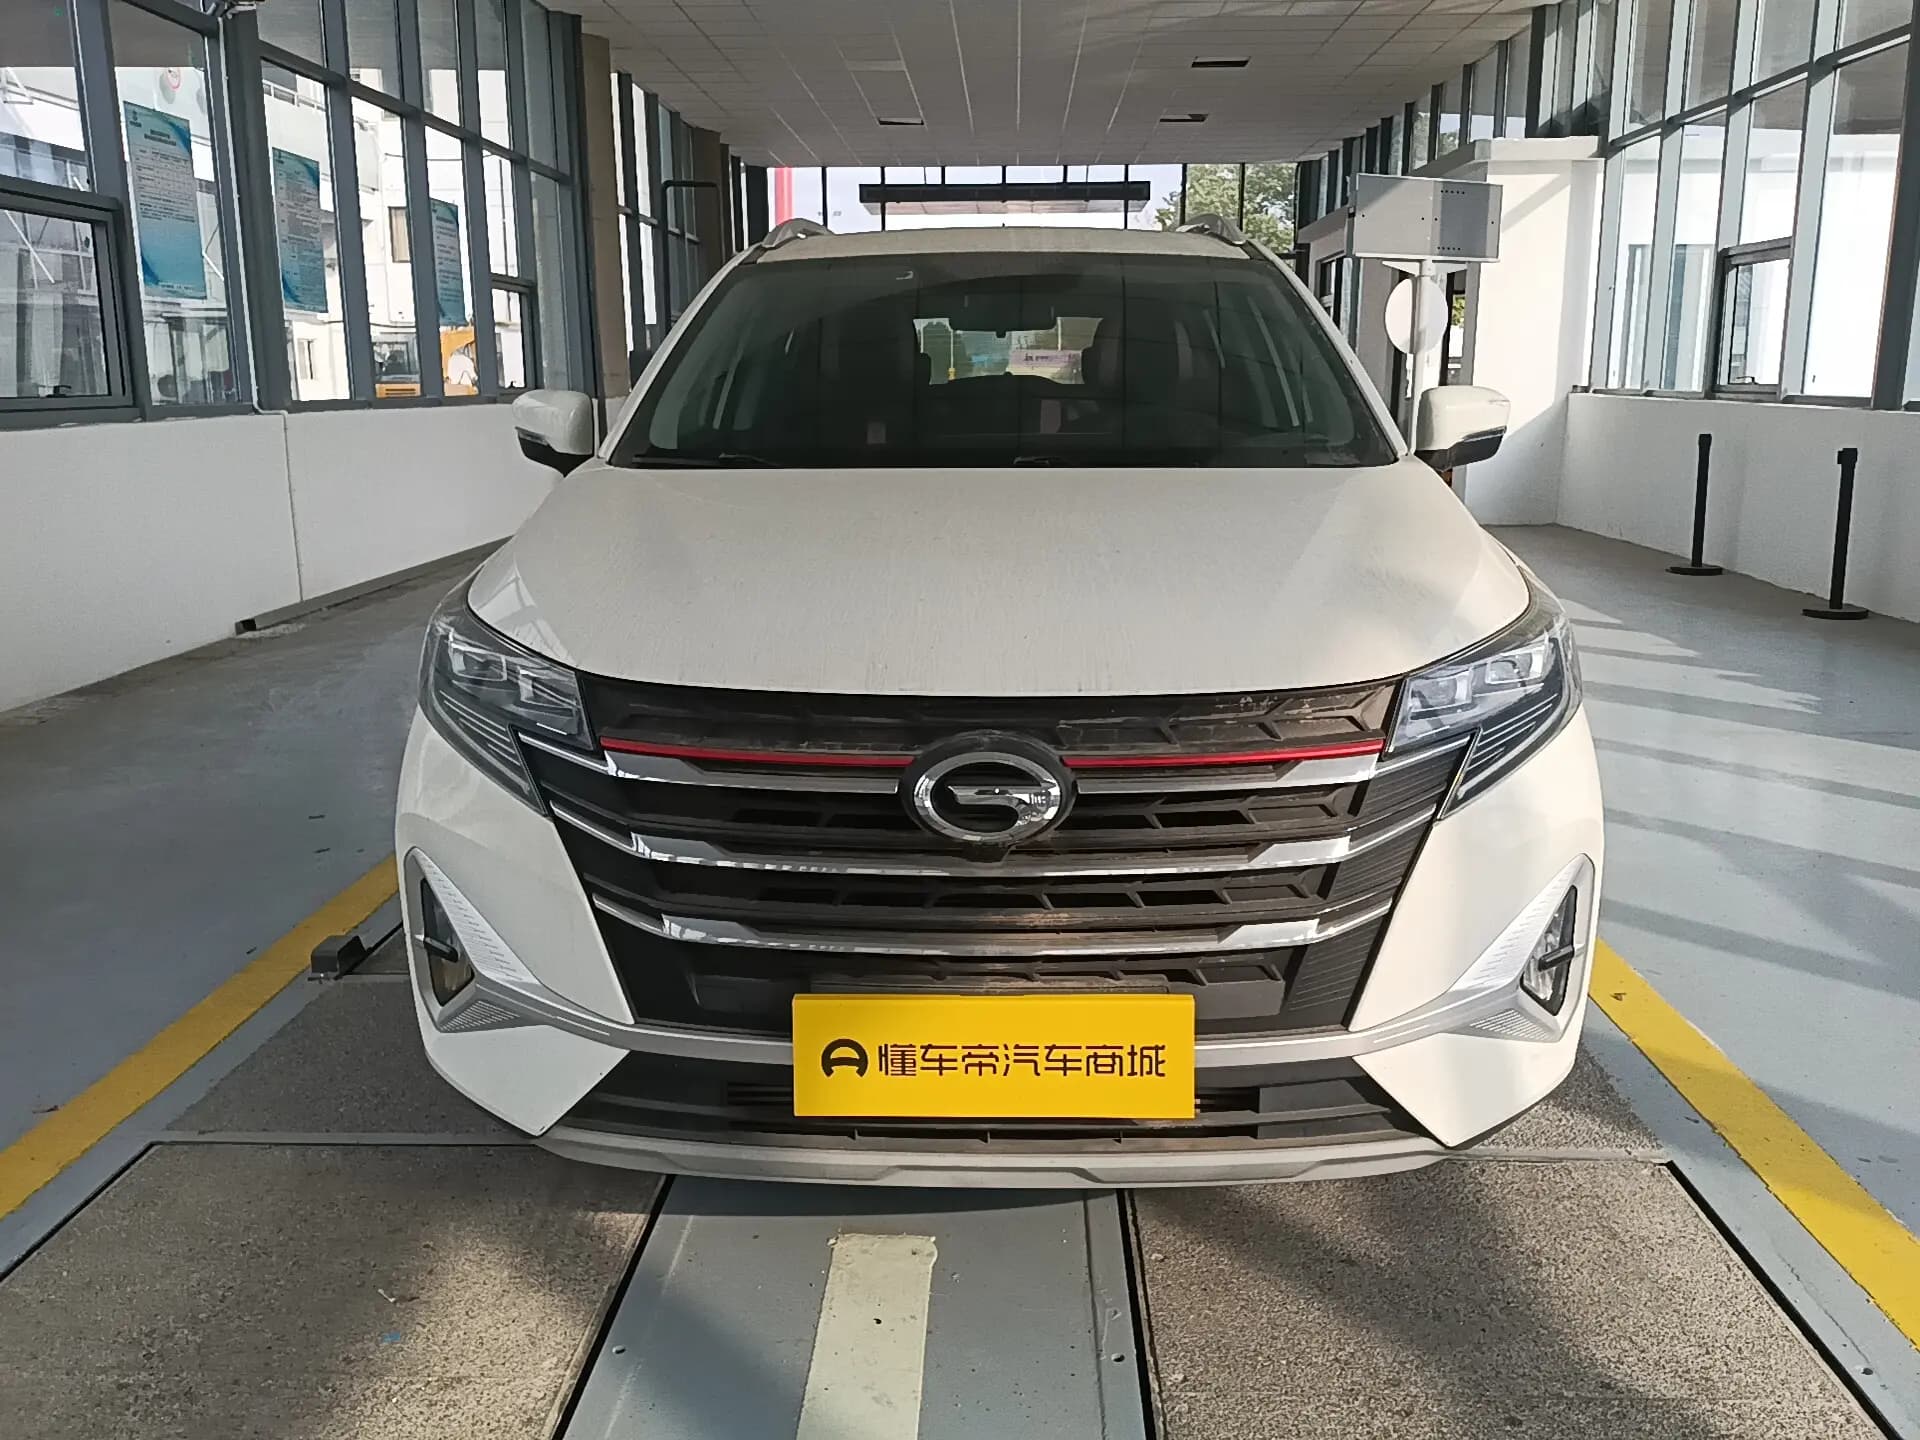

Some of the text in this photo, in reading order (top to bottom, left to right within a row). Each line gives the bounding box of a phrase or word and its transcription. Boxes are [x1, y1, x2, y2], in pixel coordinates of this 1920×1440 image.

[877, 1042, 1167, 1078] 懂车帝汽车商城
